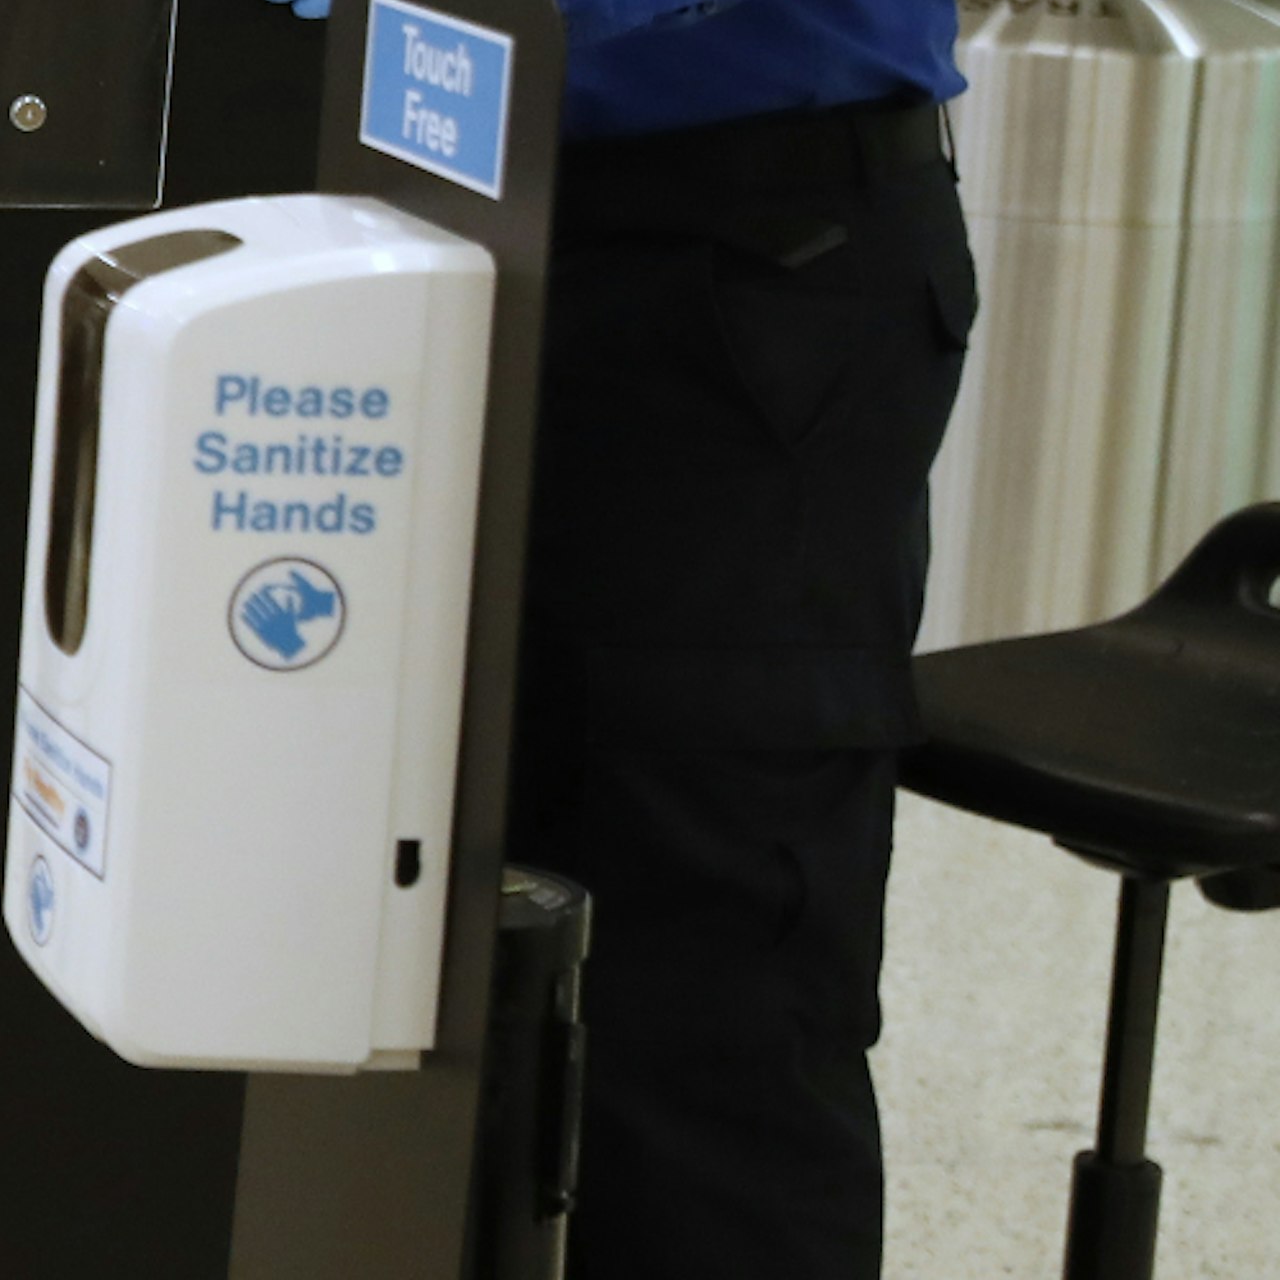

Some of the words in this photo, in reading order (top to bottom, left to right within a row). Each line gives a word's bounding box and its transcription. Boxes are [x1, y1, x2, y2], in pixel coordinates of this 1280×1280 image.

[402, 24, 472, 96] Touch
[401, 89, 458, 157] Free
[214, 374, 390, 419] Please
[194, 430, 404, 478] Sanitize
[212, 490, 376, 535] Hands
